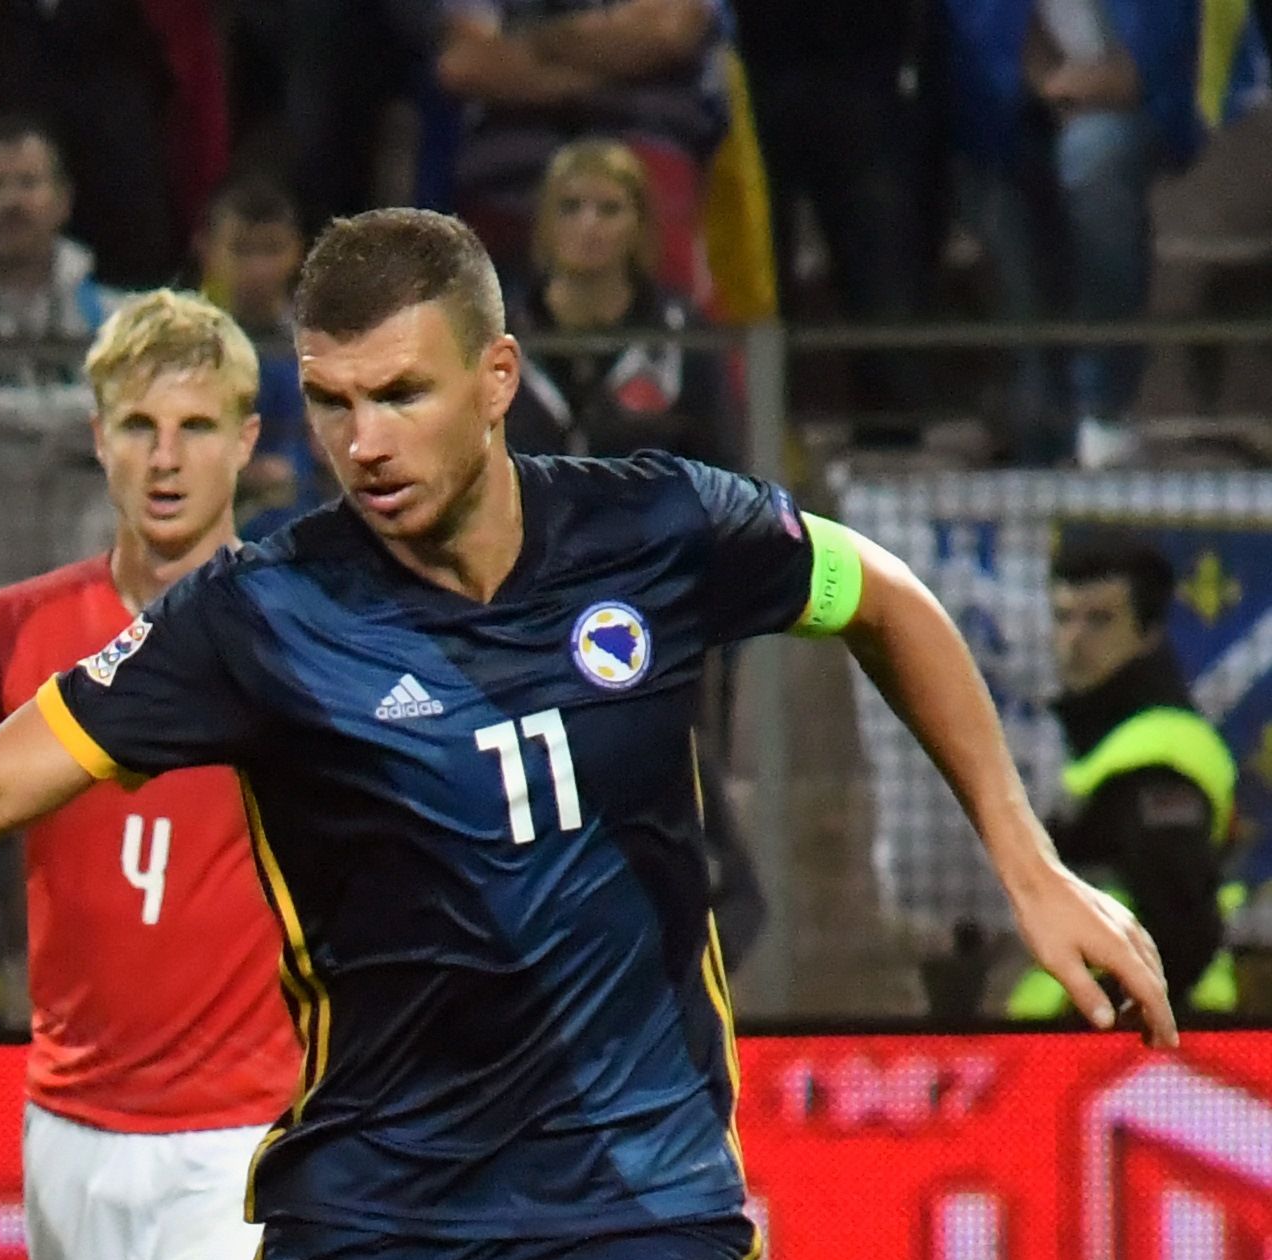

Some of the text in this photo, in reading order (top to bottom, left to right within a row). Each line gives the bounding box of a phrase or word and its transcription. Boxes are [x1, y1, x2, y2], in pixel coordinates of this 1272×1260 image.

[376, 700, 444, 720] adidas
[474, 707, 583, 845] 11
[121, 813, 172, 926] 4
